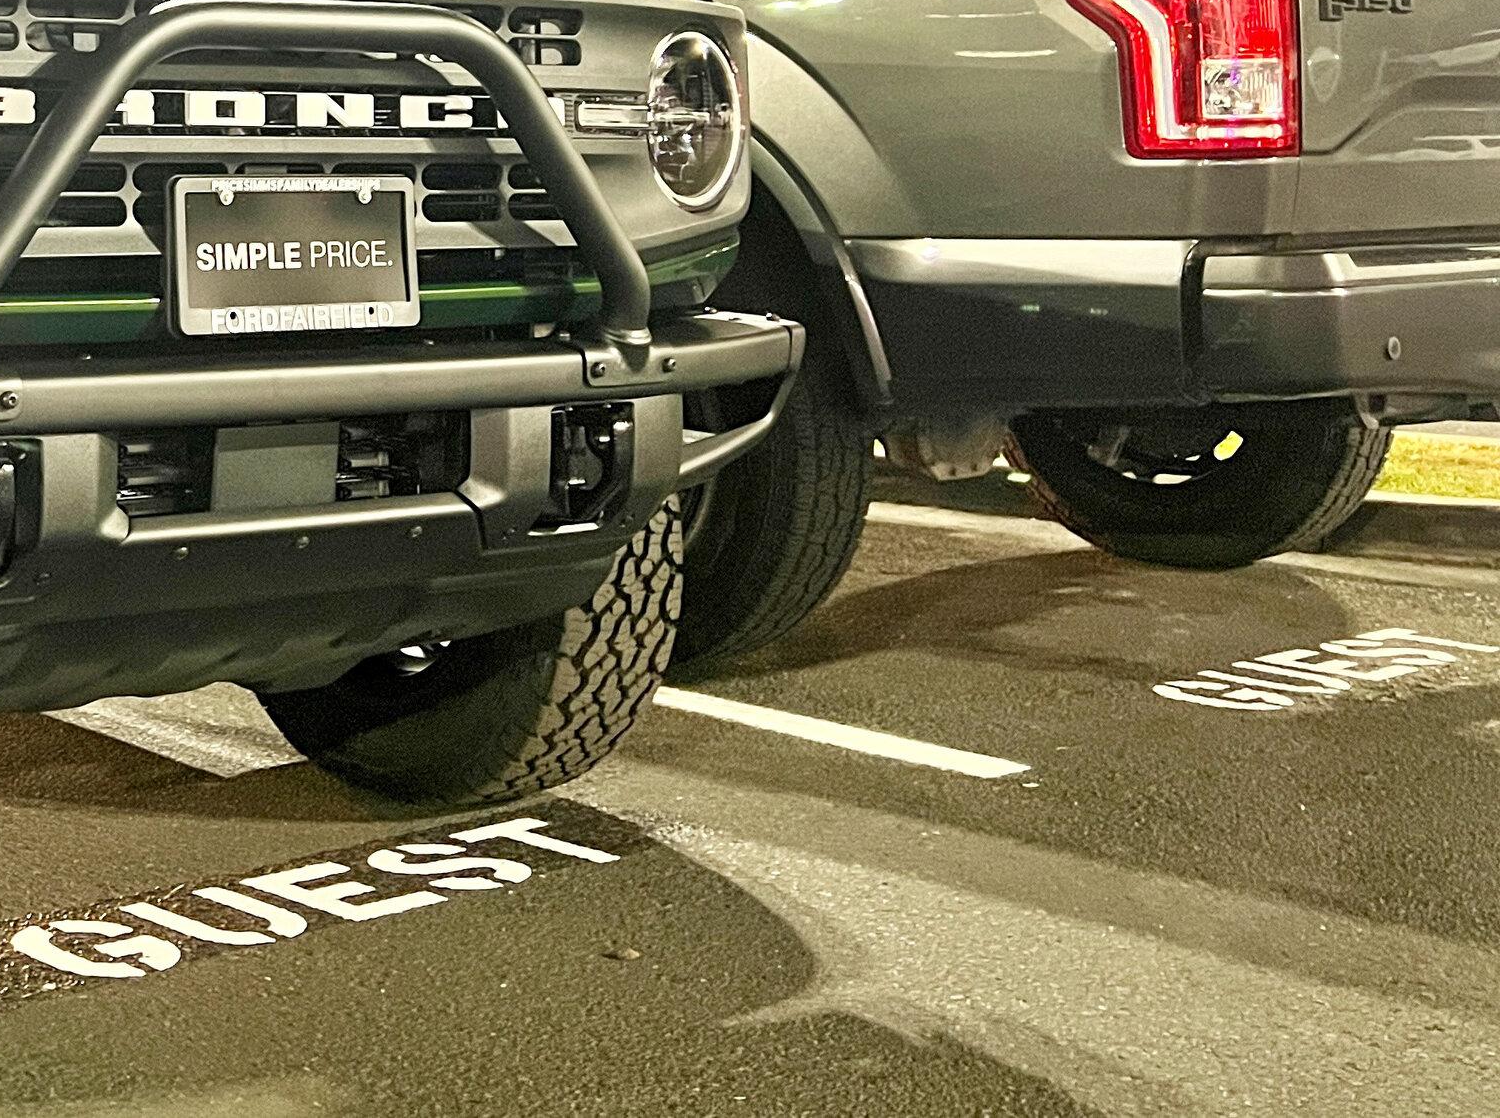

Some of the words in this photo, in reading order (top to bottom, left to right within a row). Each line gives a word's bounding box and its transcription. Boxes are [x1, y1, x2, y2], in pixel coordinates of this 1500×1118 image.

[196, 241, 302, 272] SIMPLE
[309, 239, 394, 269] PRICE.
[1152, 628, 1499, 710] GUEST
[11, 817, 621, 978] GUEST
